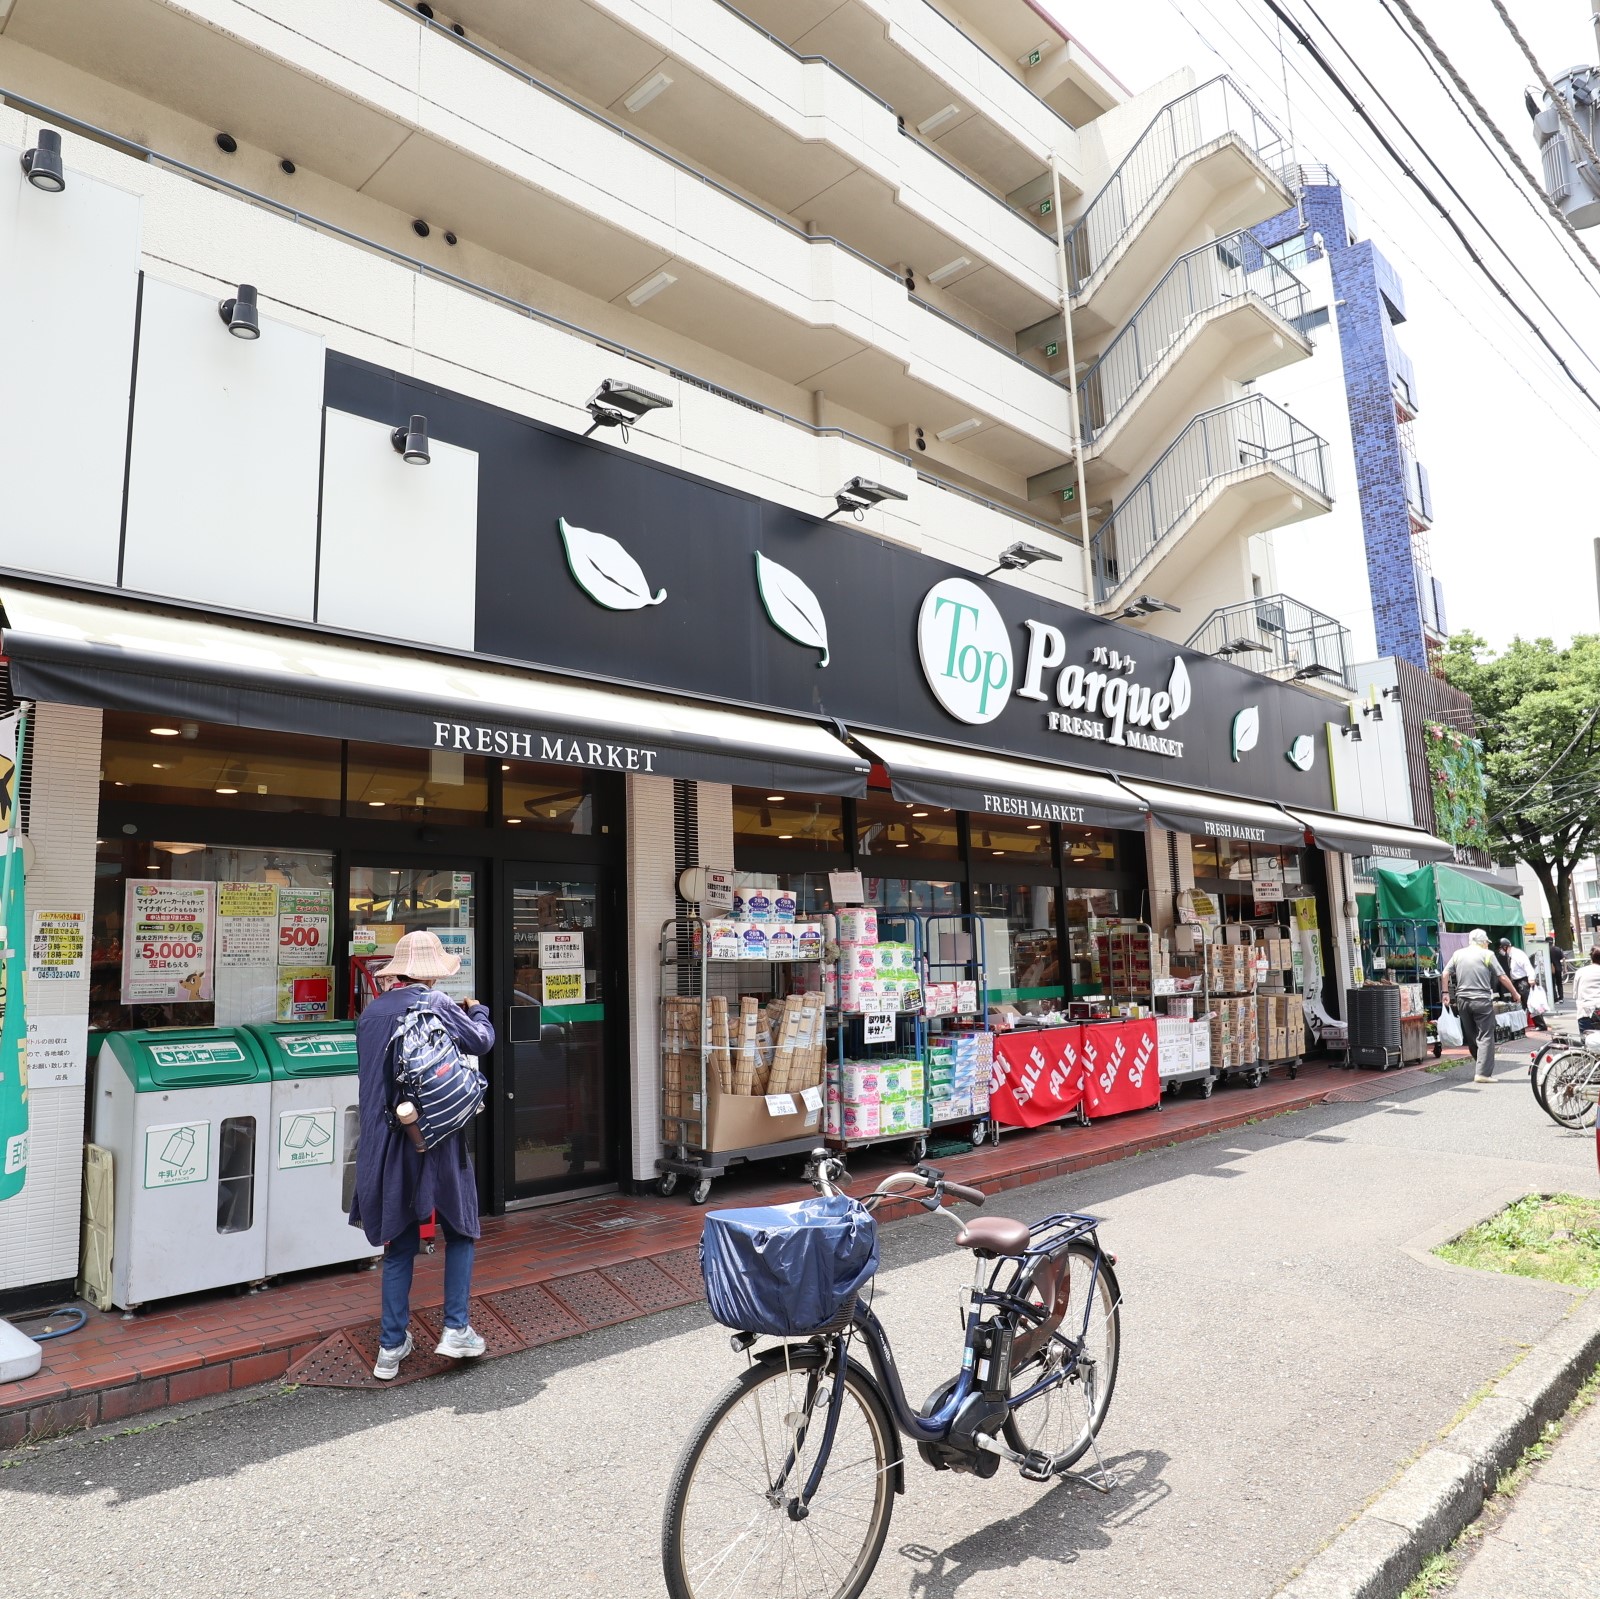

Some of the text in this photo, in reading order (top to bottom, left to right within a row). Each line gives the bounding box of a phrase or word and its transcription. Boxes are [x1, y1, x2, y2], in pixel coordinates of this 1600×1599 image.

[934, 596, 1008, 715] Top
[1016, 618, 1172, 746] Parque
[1048, 711, 1184, 758] FRESH MARKET
[433, 721, 656, 772] FRESH MARKET
[983, 794, 1084, 823] FRESH MARKET
[1204, 821, 1265, 841] FRESH MARKET
[1372, 844, 1412, 859] FRESH MARKET
[222, 883, 274, 893] 宅配サービス
[137, 898, 204, 906] マイナンバーカードを作って
[280, 927, 319, 946] 500
[142, 943, 197, 959] 5,000
[149, 960, 189, 968] 翌日もらえる
[295, 1002, 326, 1012] SECOM
[868, 1014, 892, 1024] 取り替え
[1100, 1036, 1126, 1094] SALE
[1128, 1032, 1154, 1089] SALE
[1012, 1046, 1045, 1106] SALE
[291, 1151, 324, 1160] 食品トレー
[158, 1167, 196, 1178] 牛乳パック
